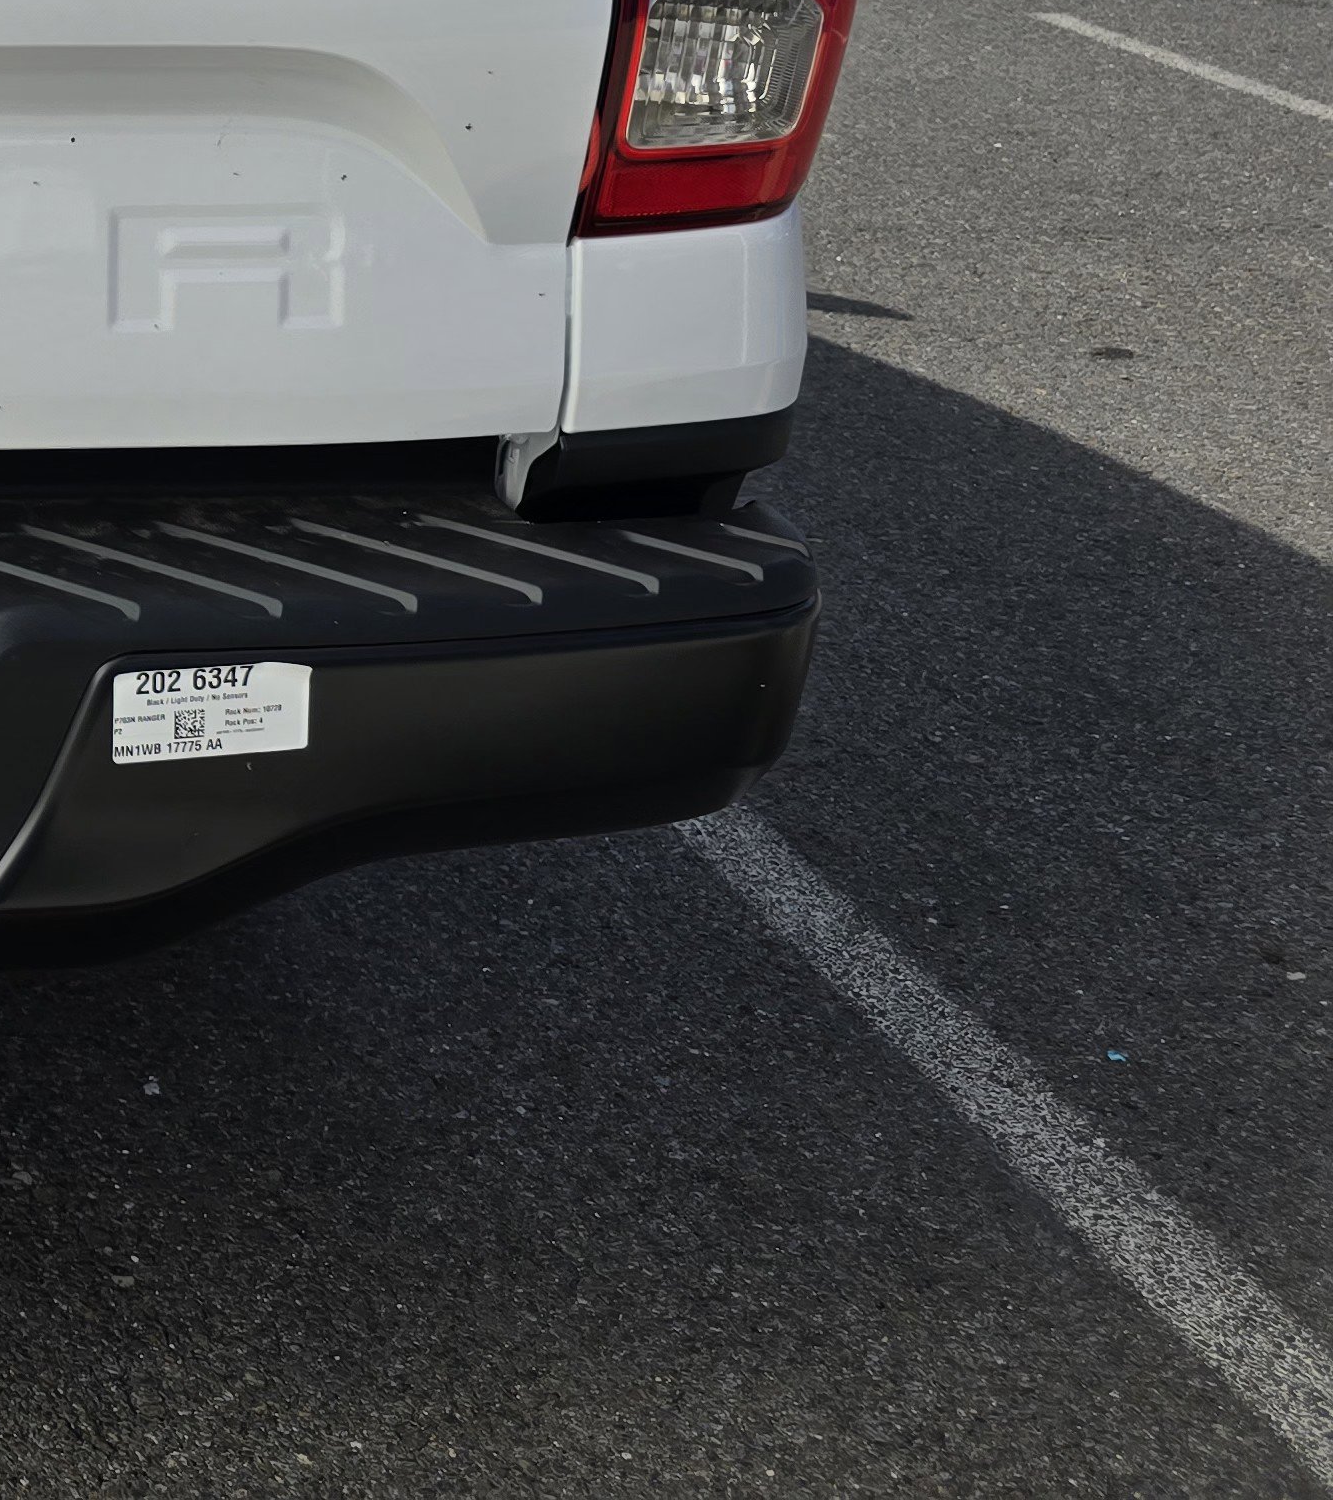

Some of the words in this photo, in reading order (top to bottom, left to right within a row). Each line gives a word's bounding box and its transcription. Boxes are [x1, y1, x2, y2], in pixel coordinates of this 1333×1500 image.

[136, 670, 182, 695] 202
[192, 665, 254, 690] 6347
[146, 698, 164, 706] Black
[170, 697, 188, 705] Light
[190, 695, 204, 703] Duty
[222, 692, 248, 700] Sensors
[137, 714, 166, 722] RANGER
[114, 743, 161, 757] MN1WB
[167, 740, 202, 753] 17775
[206, 738, 222, 750] AA
